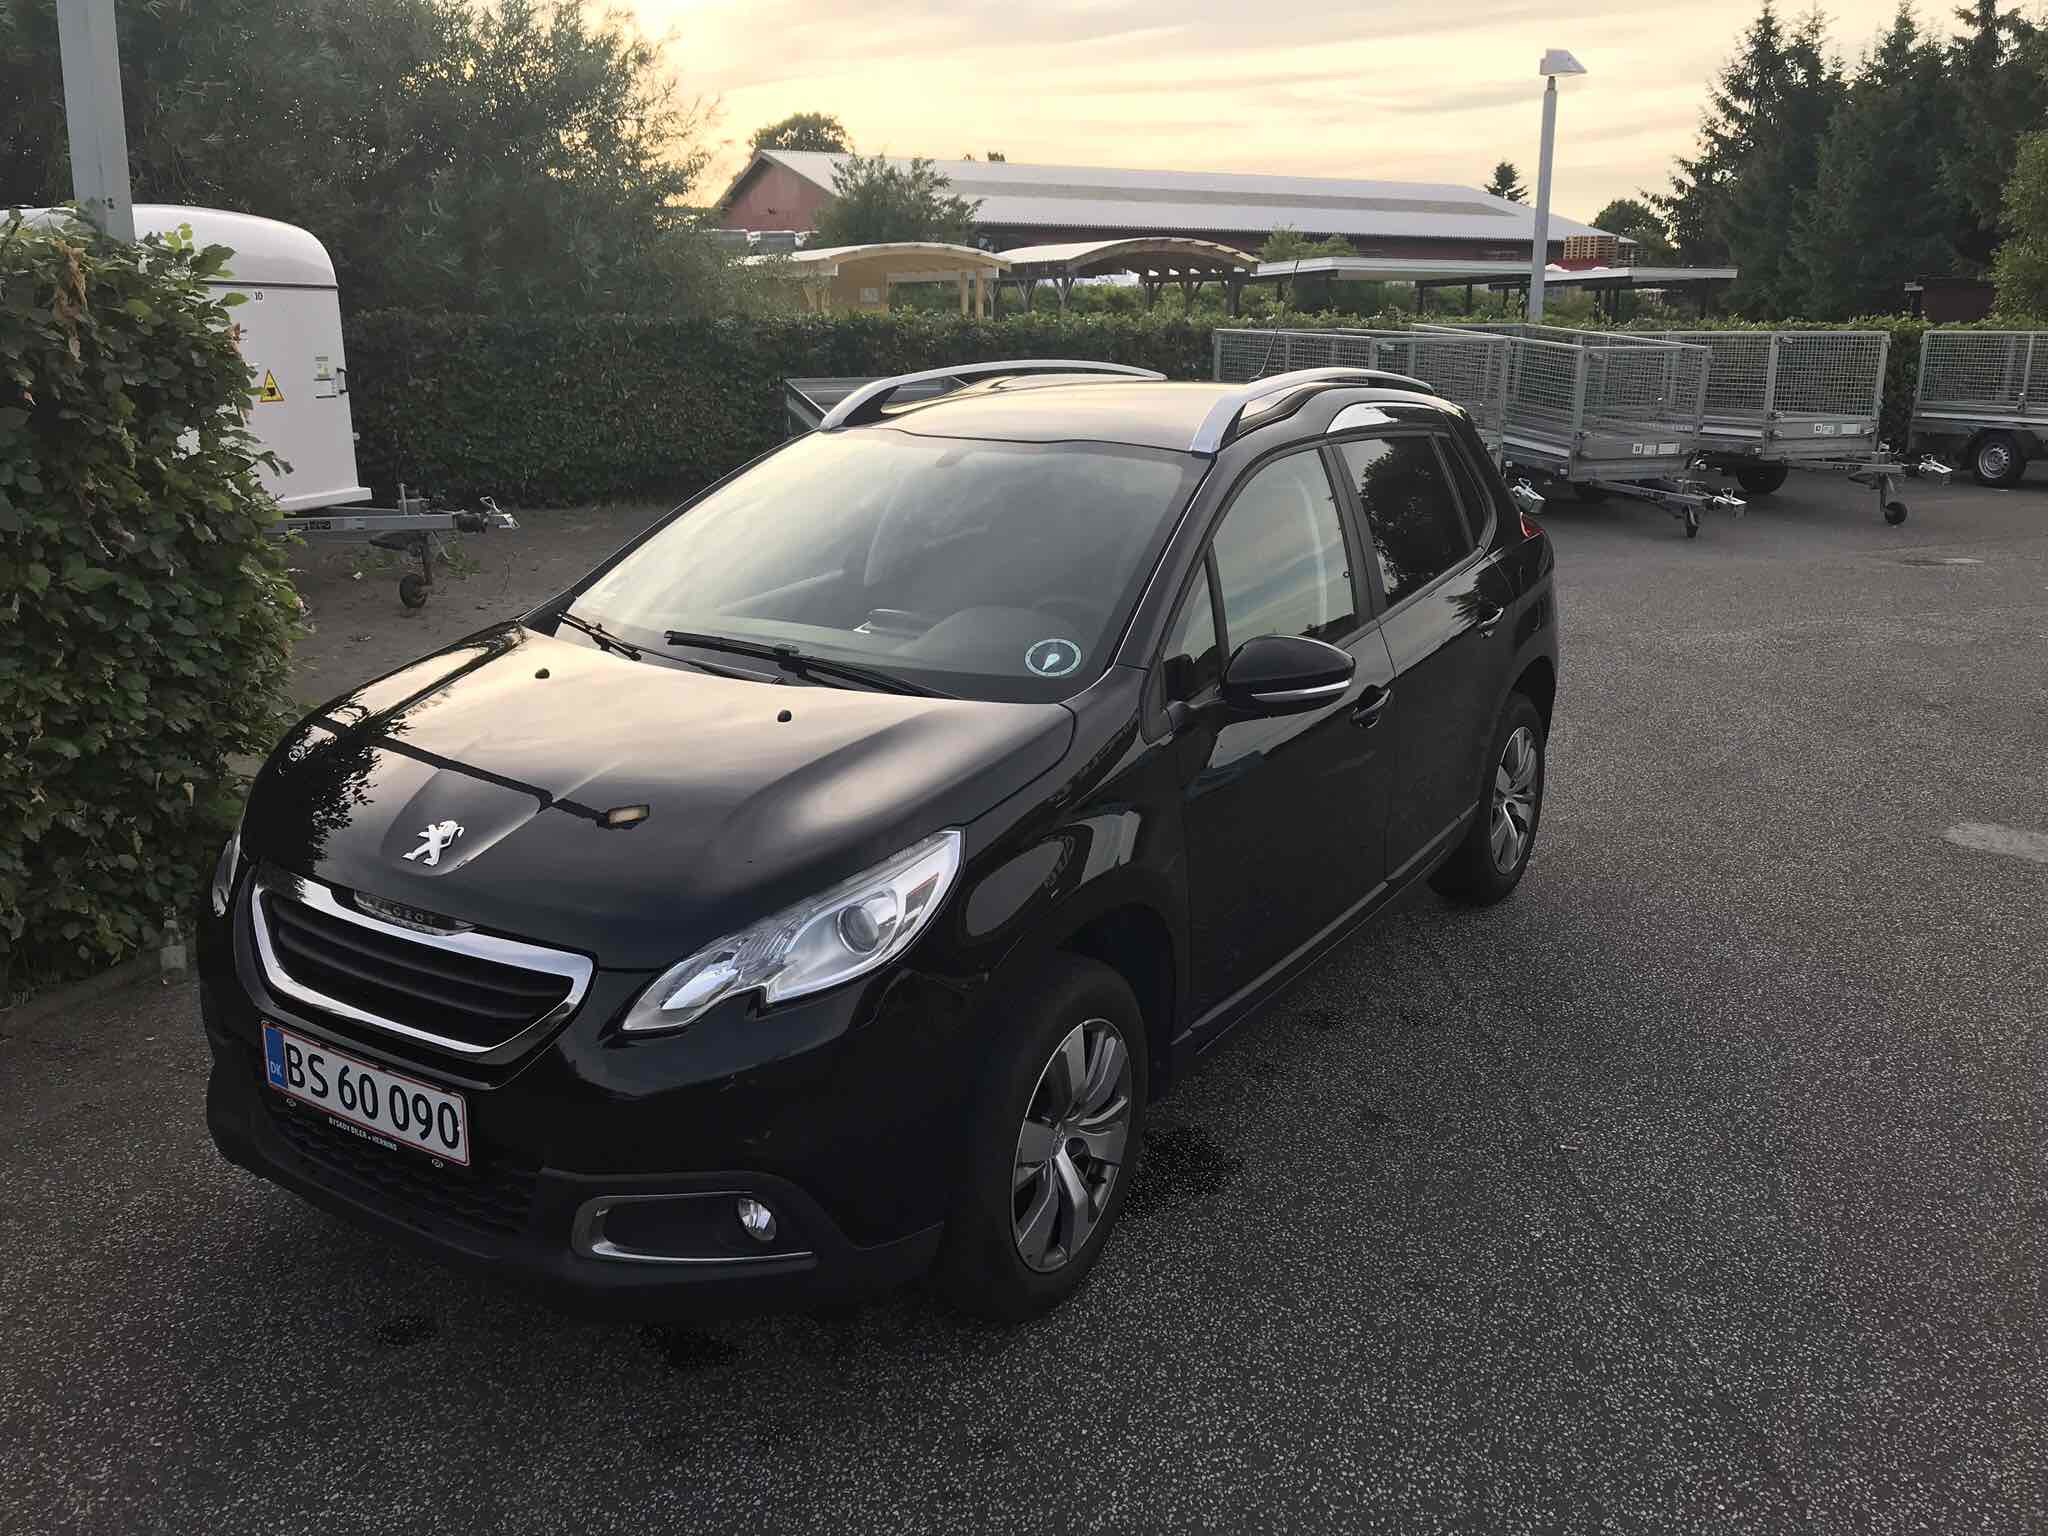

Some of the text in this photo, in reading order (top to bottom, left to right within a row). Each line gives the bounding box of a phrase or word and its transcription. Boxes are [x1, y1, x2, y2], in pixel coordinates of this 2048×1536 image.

[270, 1063, 283, 1078] DK
[286, 1041, 460, 1150] BS 60 090
